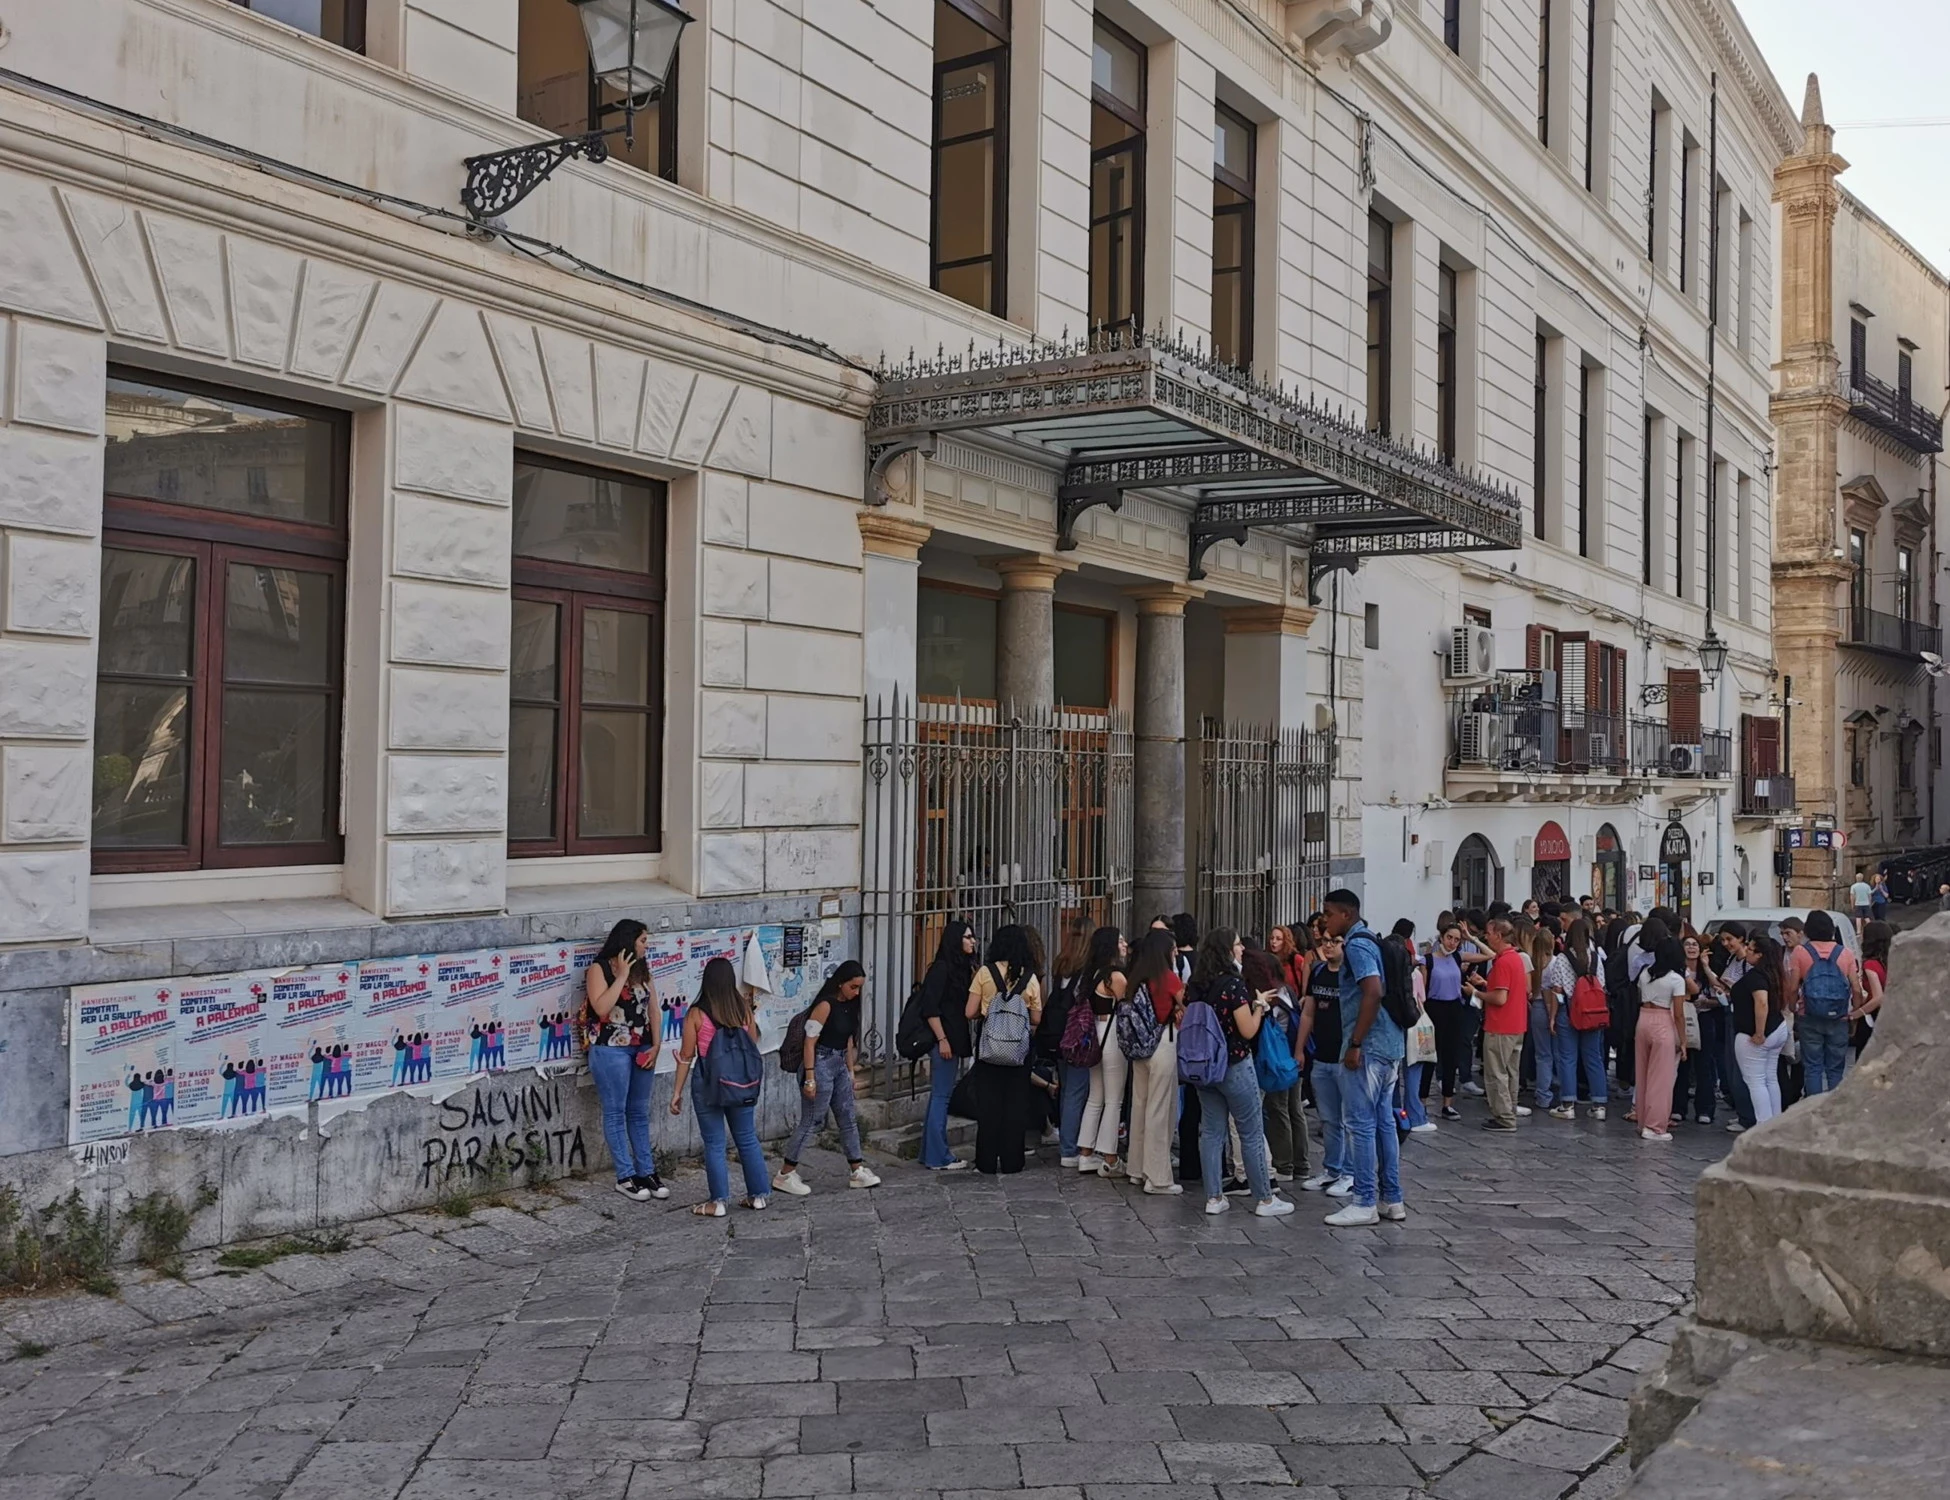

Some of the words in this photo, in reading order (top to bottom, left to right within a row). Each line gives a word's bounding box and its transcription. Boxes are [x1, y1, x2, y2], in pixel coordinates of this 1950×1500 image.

[1666, 839, 1687, 855] KATIA
[438, 966, 466, 975] COMITATI
[528, 965, 566, 983] PALERMO!
[360, 974, 390, 983] COMITATI
[360, 983, 372, 991] PER
[373, 982, 382, 990] LA
[383, 980, 407, 988] SALUTE
[450, 983, 457, 993] A
[458, 972, 499, 991] PALERMO!
[273, 983, 306, 993] COMITATI
[273, 992, 287, 1000] PER
[288, 991, 298, 999] LA
[300, 989, 325, 998] SALUTE
[373, 992, 380, 1003] A
[382, 980, 427, 1000] PALERMO!
[180, 996, 216, 1006] COMITATI
[180, 1006, 195, 1015] PER
[197, 1005, 207, 1014] LA
[208, 1002, 236, 1012] SALUTE
[288, 1002, 296, 1014] A
[298, 989, 347, 1011] PALERMO!
[81, 1004, 119, 1015] COMITATI
[81, 1015, 96, 1024] PER
[99, 1014, 109, 1023] LA
[112, 1010, 142, 1021] SALUTE
[196, 1016, 205, 1028] A
[207, 1003, 260, 1025] PALERMO!
[99, 1025, 108, 1037] A
[110, 1009, 167, 1033] PALERMO!
[440, 1083, 561, 1131] SALVINI
[423, 1126, 587, 1189] PARASSITA
